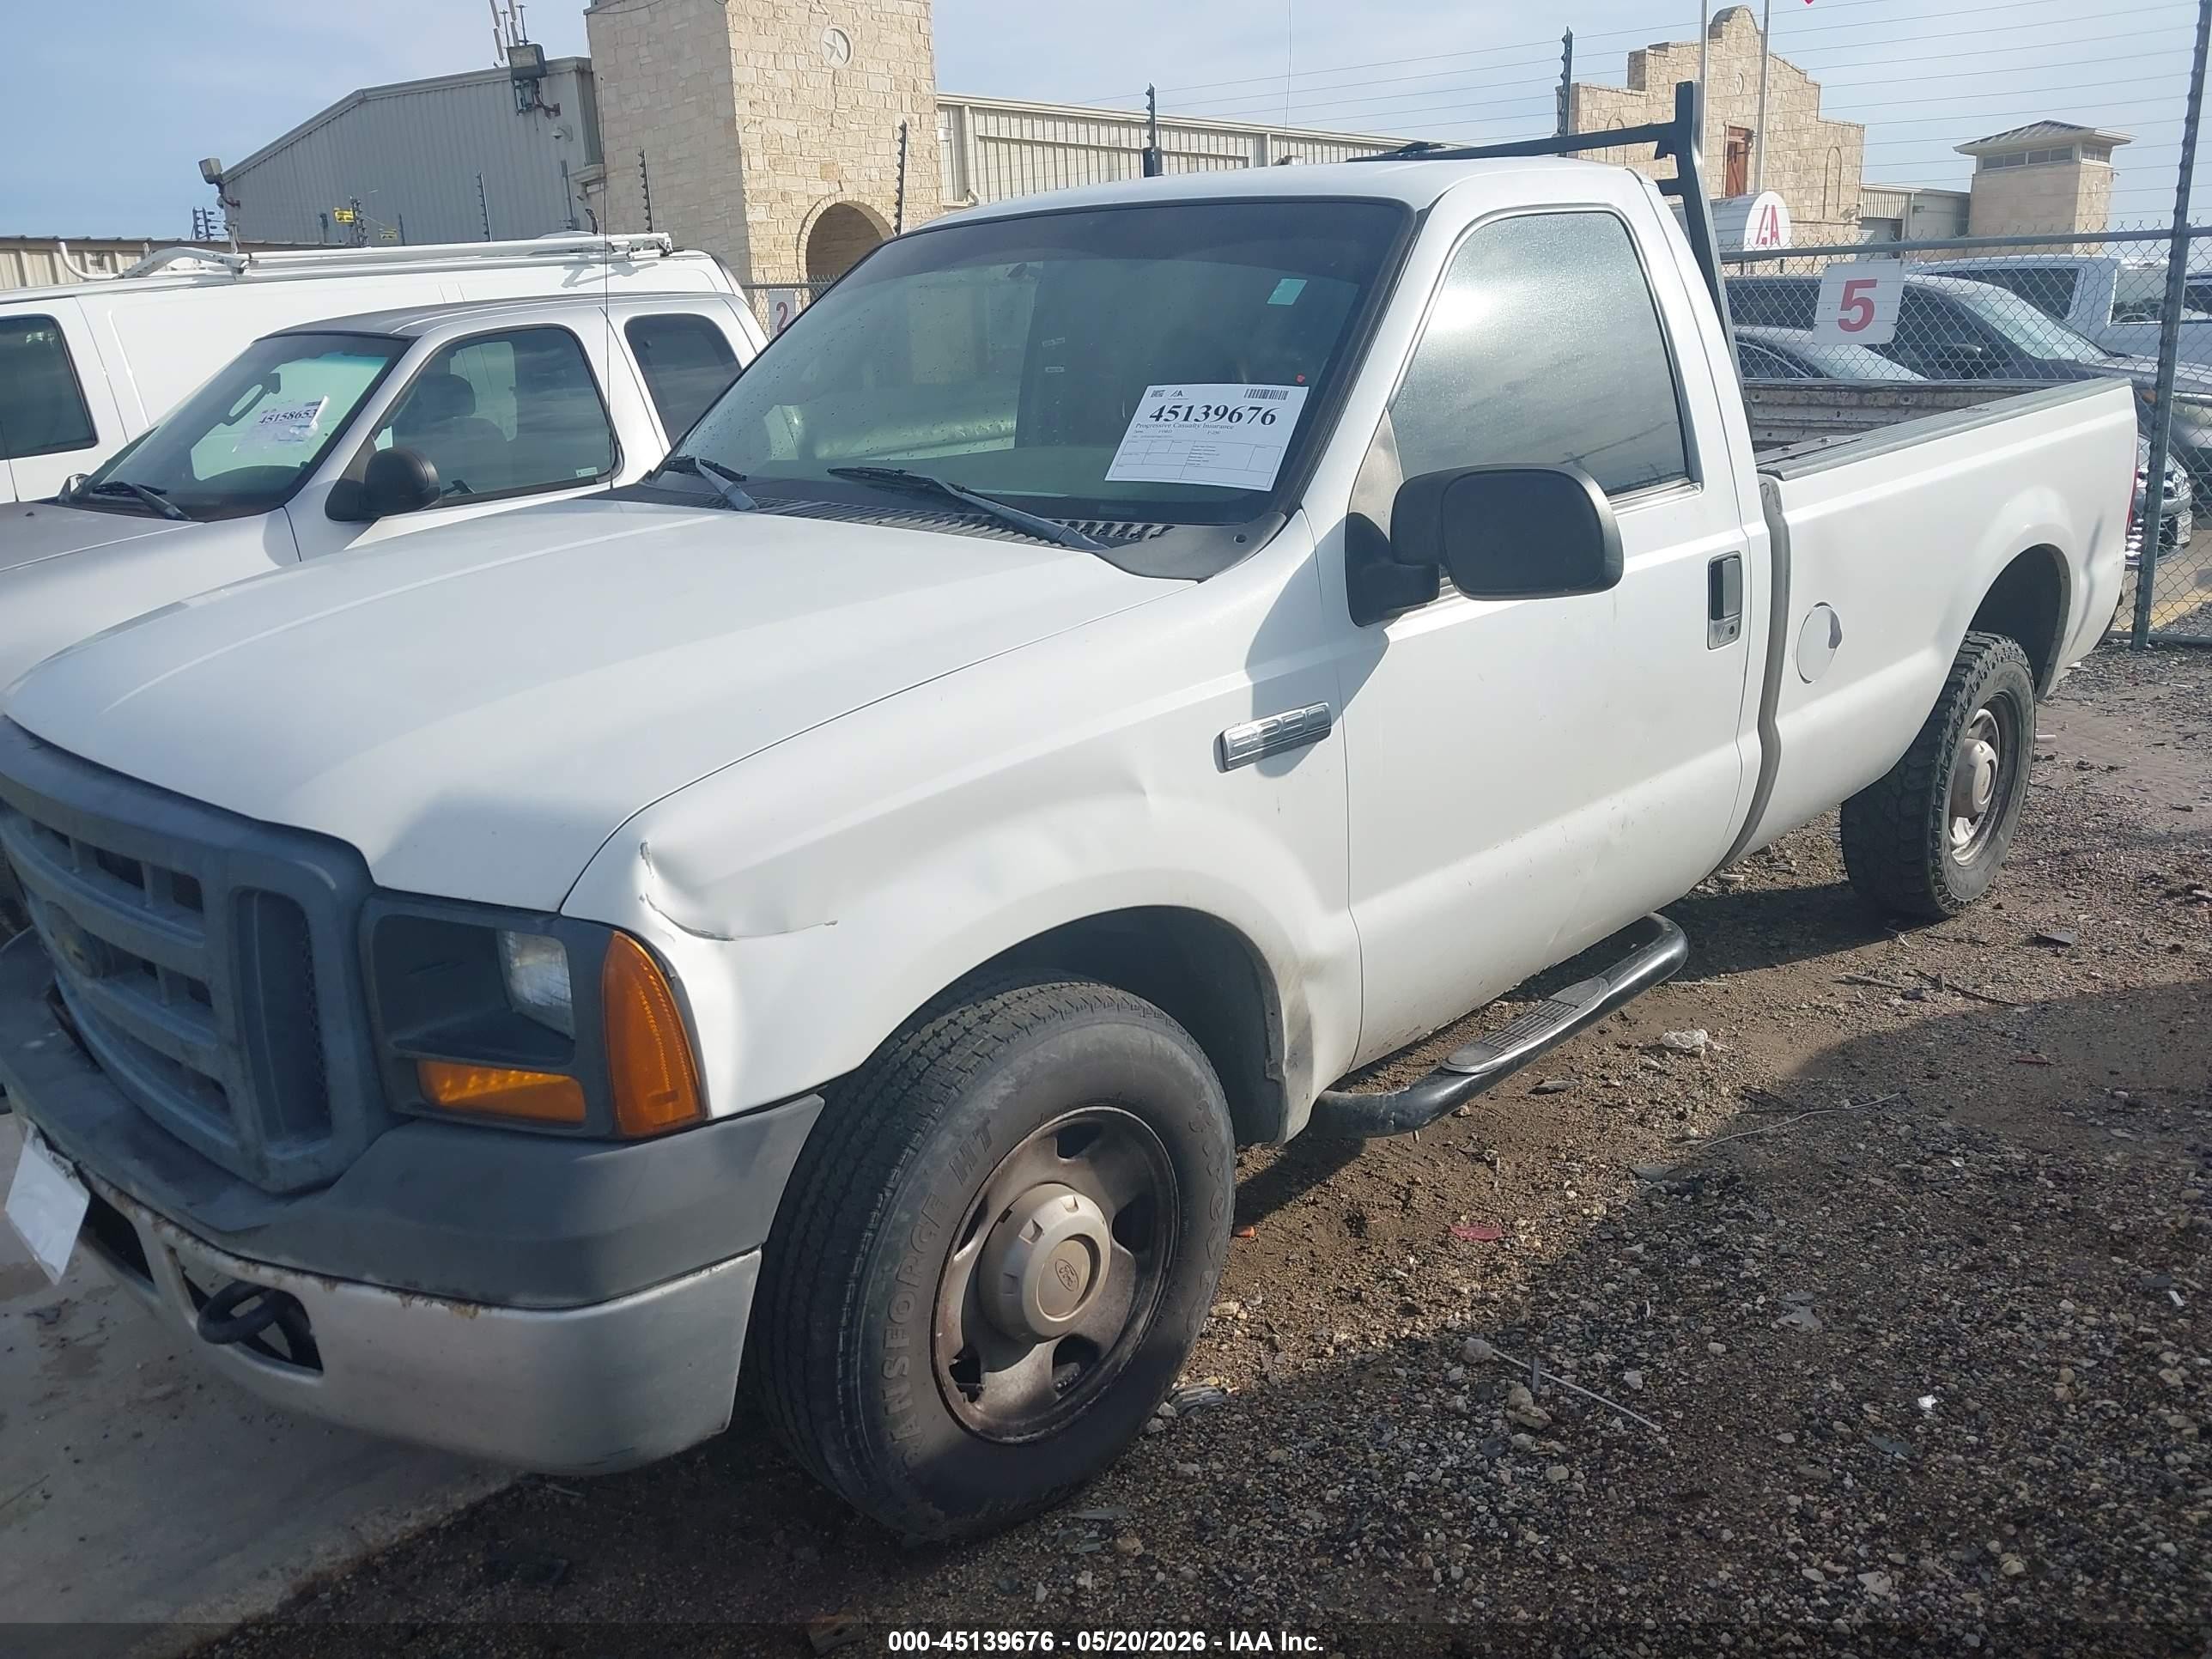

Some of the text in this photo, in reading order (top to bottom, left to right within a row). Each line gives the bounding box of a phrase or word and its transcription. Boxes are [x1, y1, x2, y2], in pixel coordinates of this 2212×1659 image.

[776, 302, 788, 333] 2
[1838, 279, 1877, 332] 5
[1149, 404, 1280, 425] 45139676
